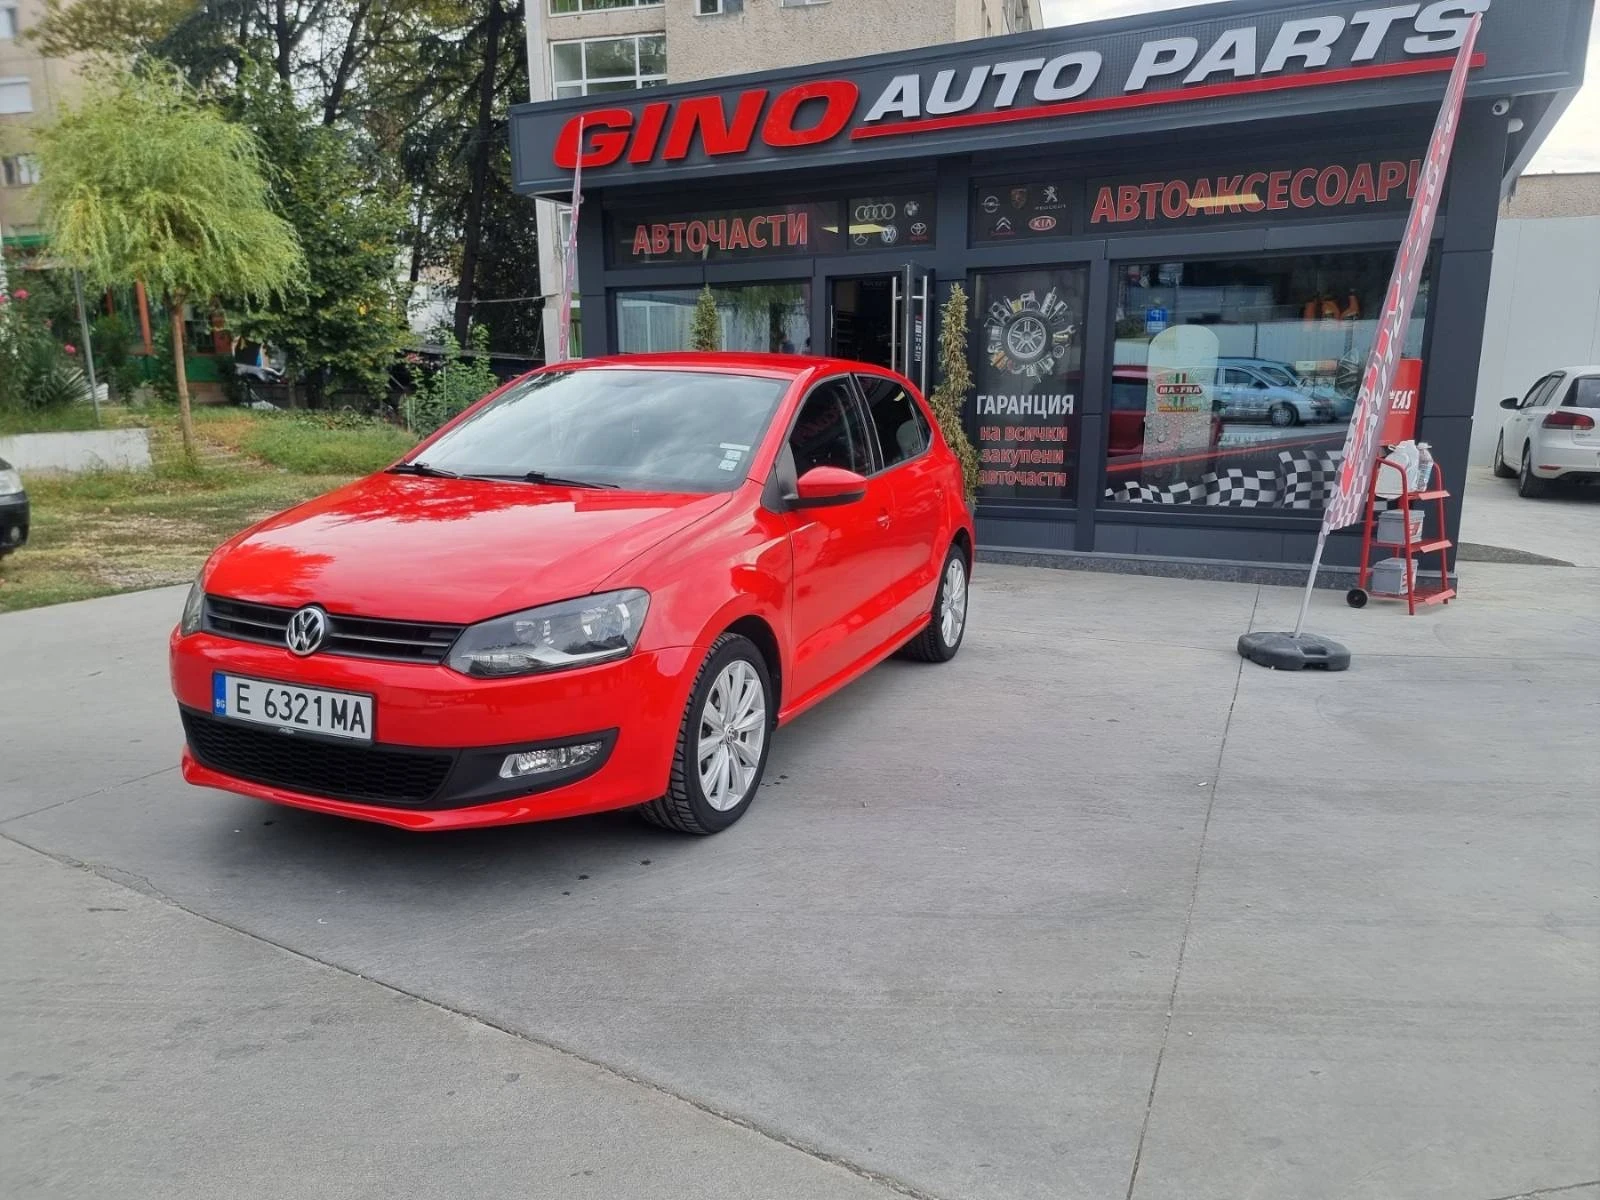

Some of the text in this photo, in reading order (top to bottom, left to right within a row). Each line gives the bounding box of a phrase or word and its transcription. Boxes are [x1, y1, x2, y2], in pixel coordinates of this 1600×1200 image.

[553, 0, 1491, 169] GINO AUTO PARTS
[632, 212, 808, 255] АВТОЧАСТИ
[976, 394, 1074, 419] ГАРАНЦИЯ
[980, 426, 1068, 442] на всички
[982, 447, 1064, 468] закупени
[979, 469, 1067, 487] авточасти
[215, 698, 226, 709] BG
[236, 683, 250, 714] E
